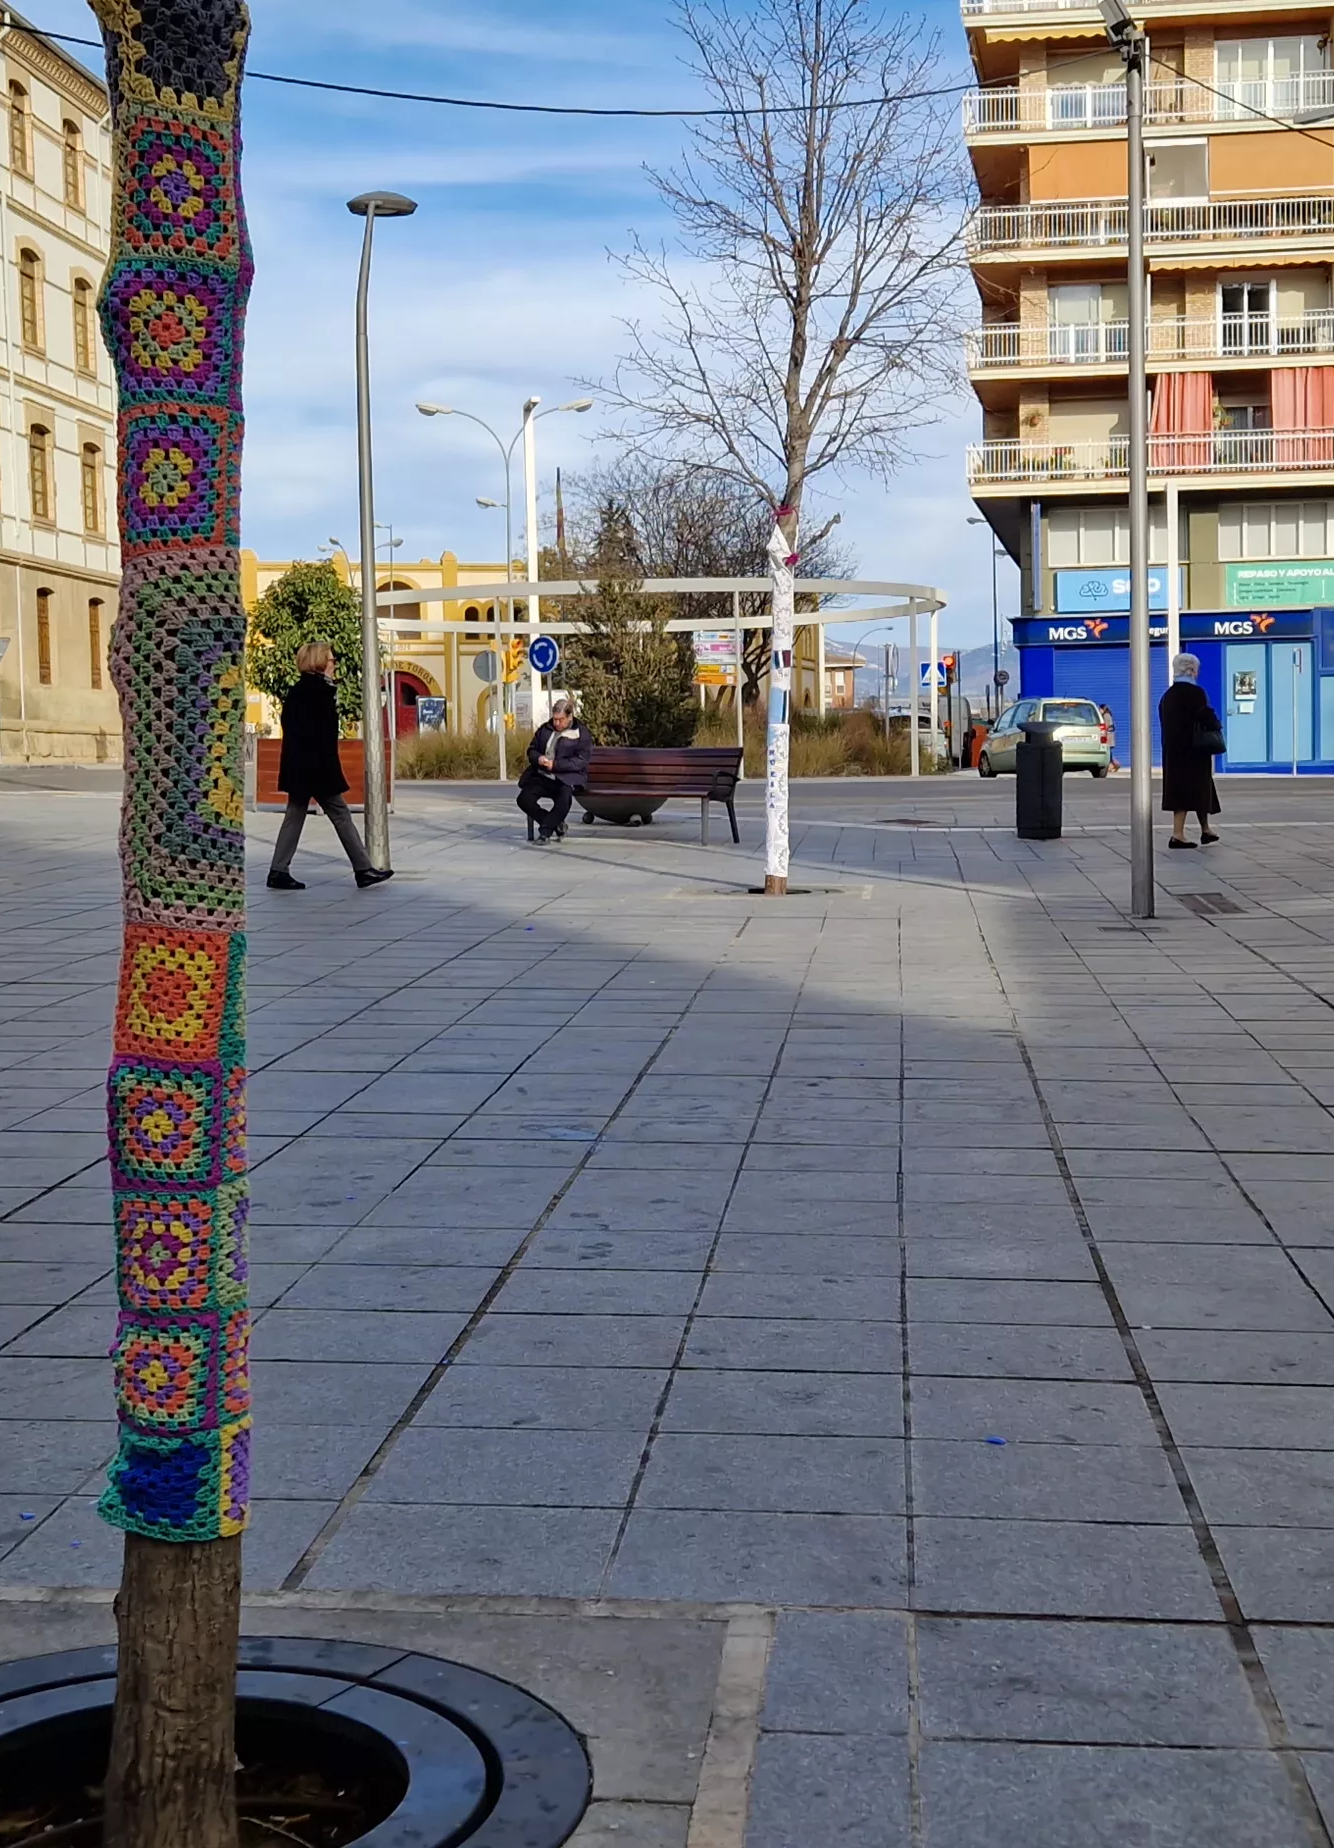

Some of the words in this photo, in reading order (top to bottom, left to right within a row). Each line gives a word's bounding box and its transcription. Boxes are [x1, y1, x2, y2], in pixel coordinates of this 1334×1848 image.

[1238, 569, 1277, 579] REPASO
[1278, 569, 1286, 577] Y
[1286, 568, 1322, 577] APOYO
[1112, 578, 1161, 594] SO
[1049, 626, 1087, 640] MGS
[1214, 621, 1254, 635] MGS
[407, 663, 434, 684] TOROS
